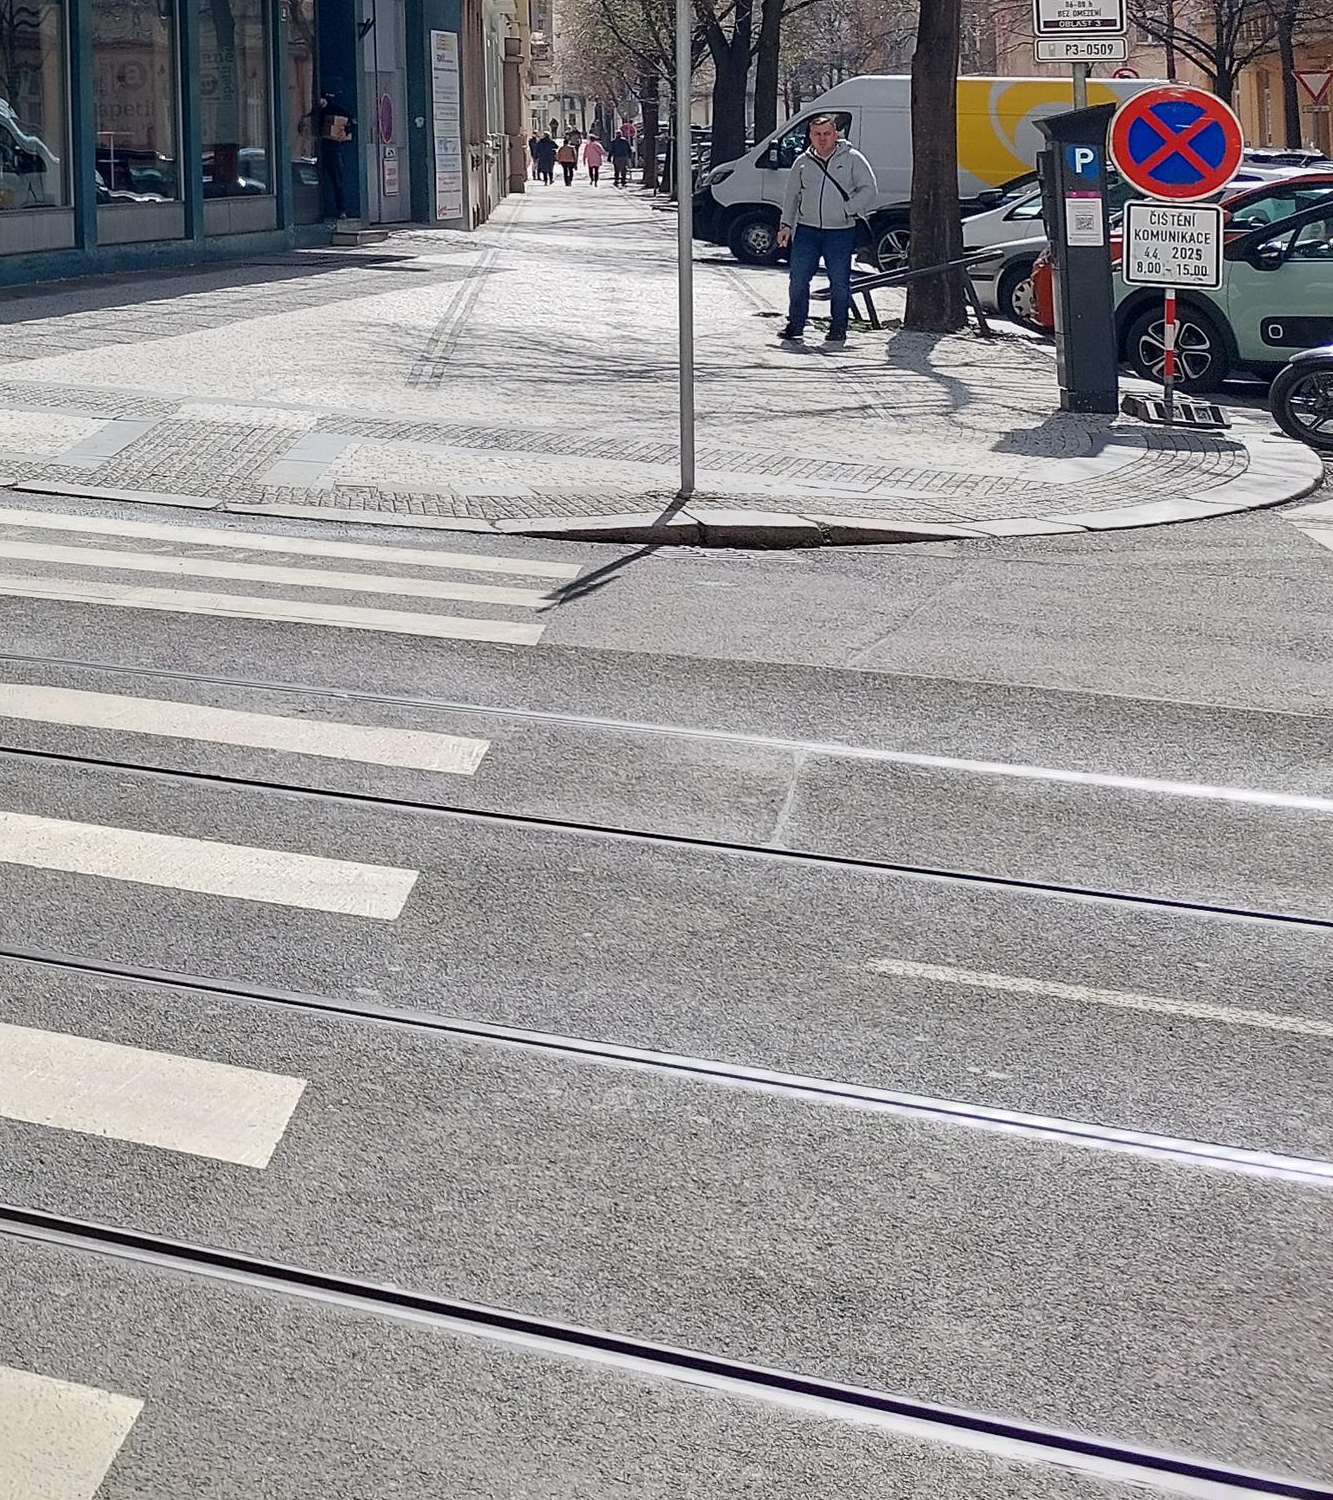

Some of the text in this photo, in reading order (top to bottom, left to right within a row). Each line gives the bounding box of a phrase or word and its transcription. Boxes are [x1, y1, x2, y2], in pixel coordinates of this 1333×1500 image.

[1059, 20, 1092, 28] OBLAST
[1065, 43, 1114, 56] P3-0509
[1074, 147, 1094, 174] P
[1149, 210, 1196, 227] ČIŠTĚNÍ
[1134, 228, 1211, 245] KOMUNIKACE
[1172, 246, 1203, 261] 2025
